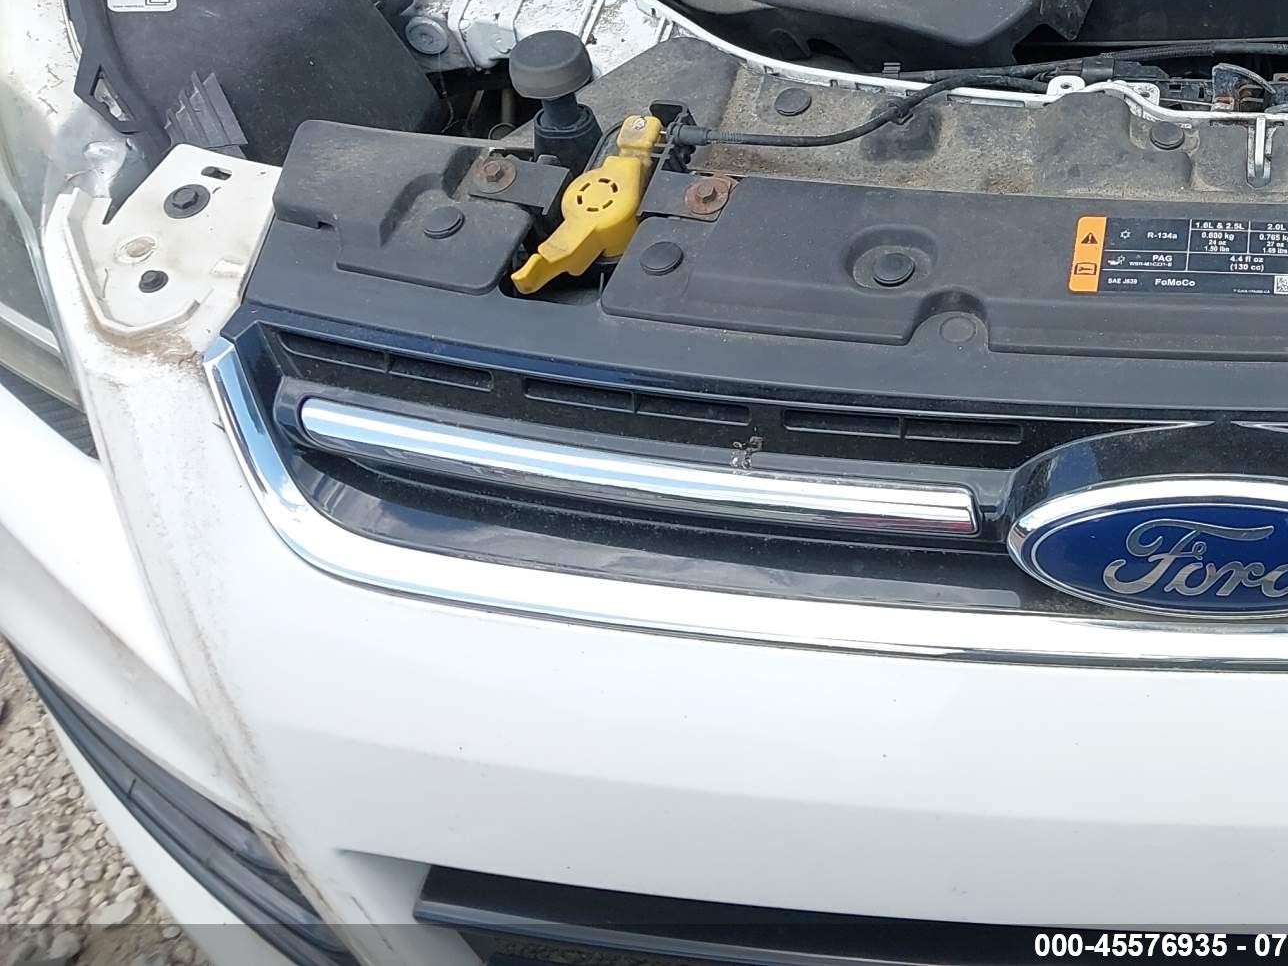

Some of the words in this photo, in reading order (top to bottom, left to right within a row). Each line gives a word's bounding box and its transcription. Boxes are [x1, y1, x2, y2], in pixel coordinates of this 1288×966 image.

[1225, 222, 1245, 230] 2.5L
[1267, 223, 1286, 231] 2.0L
[1224, 232, 1235, 241] kg
[1152, 254, 1173, 262] PAG
[1154, 278, 1196, 287] FoMoCo
